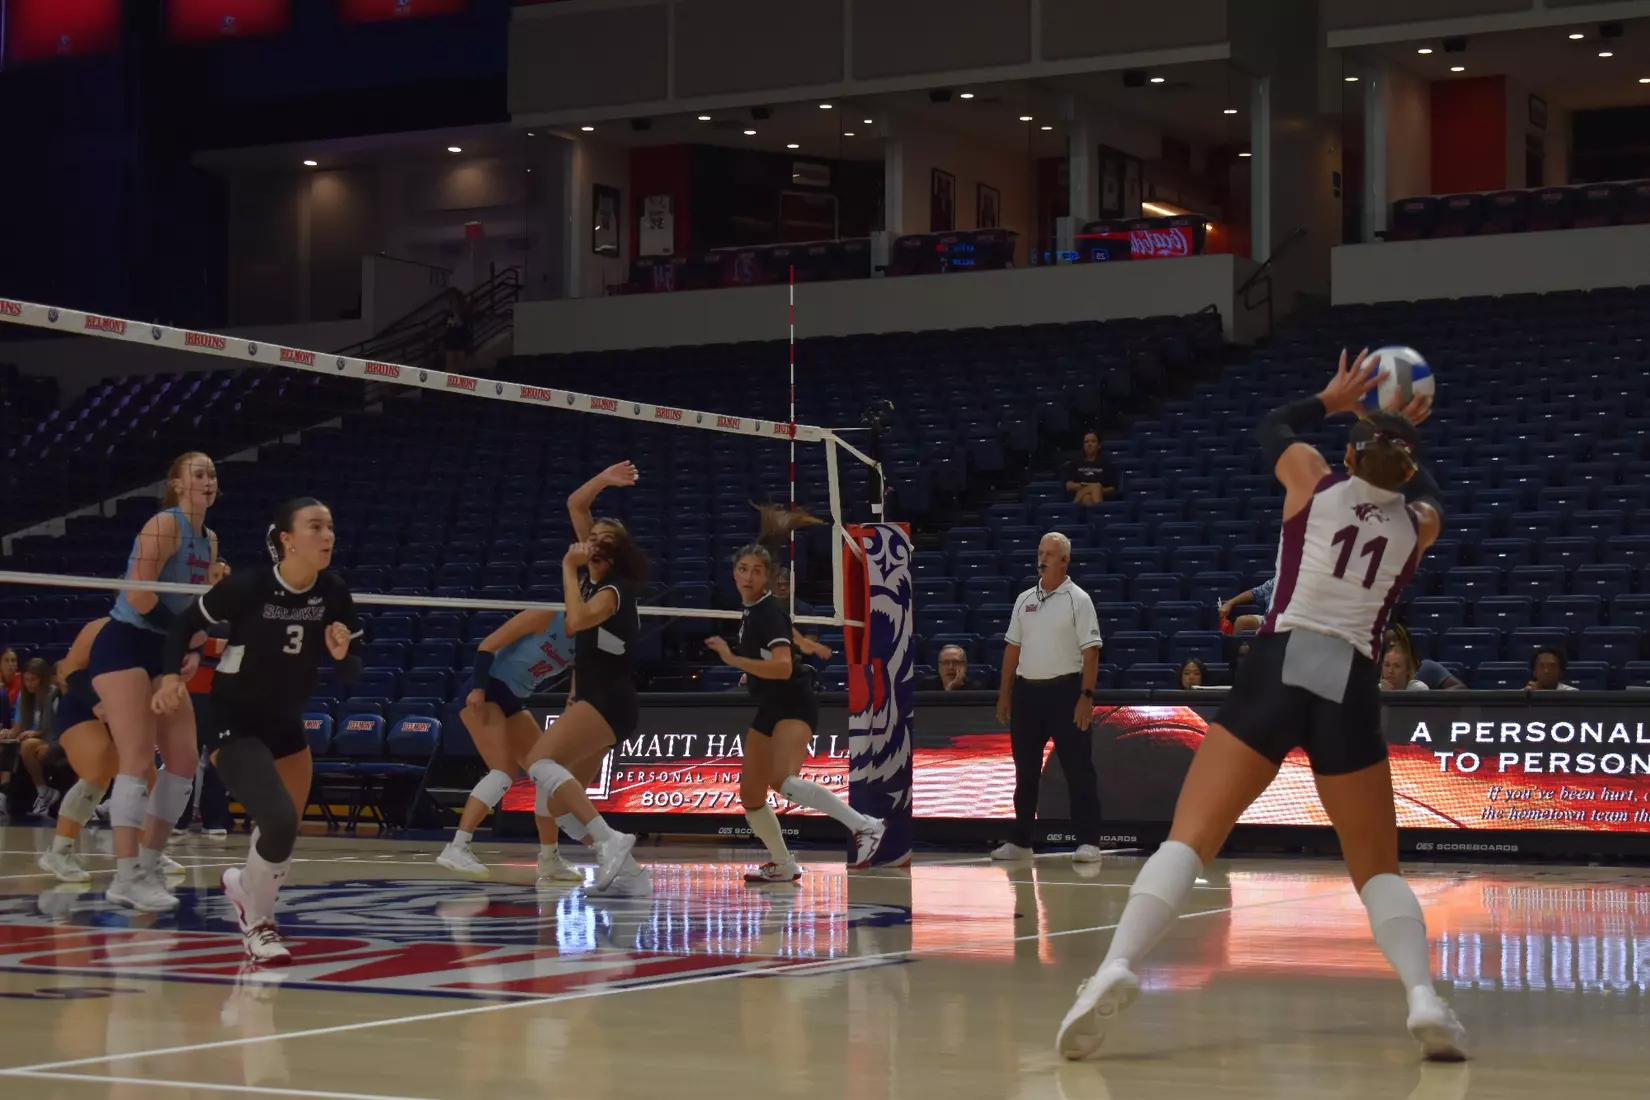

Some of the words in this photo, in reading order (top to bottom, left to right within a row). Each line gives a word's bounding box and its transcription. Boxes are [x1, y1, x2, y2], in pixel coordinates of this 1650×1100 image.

[0, 301, 22, 317] INS
[85, 314, 127, 335] BELMONT
[185, 331, 227, 350] BRUINS
[280, 347, 316, 366] BELMONT
[364, 361, 400, 377] BRUINS
[446, 375, 478, 391] BELMONT
[520, 385, 552, 402] BRUINS
[590, 396, 618, 412] BELMONT
[655, 407, 682, 421] BRUINS
[1330, 524, 1388, 589] 11
[282, 624, 304, 654] 3
[1410, 722, 1432, 742] A
[1450, 722, 1650, 743] PERSONAL
[620, 734, 697, 757] MATT
[1434, 752, 1480, 773] TO
[1498, 752, 1650, 774] PERSON
[616, 771, 704, 783] PERSONAL
[1487, 786, 1503, 802] If
[1505, 785, 1555, 802] you've
[1560, 786, 1595, 800] been
[1600, 786, 1638, 802] hurt,
[1480, 806, 1503, 820] the
[1509, 806, 1585, 820] hometown
[1591, 809, 1628, 821] team
[1436, 843, 1519, 852] SCOREBOARDS
